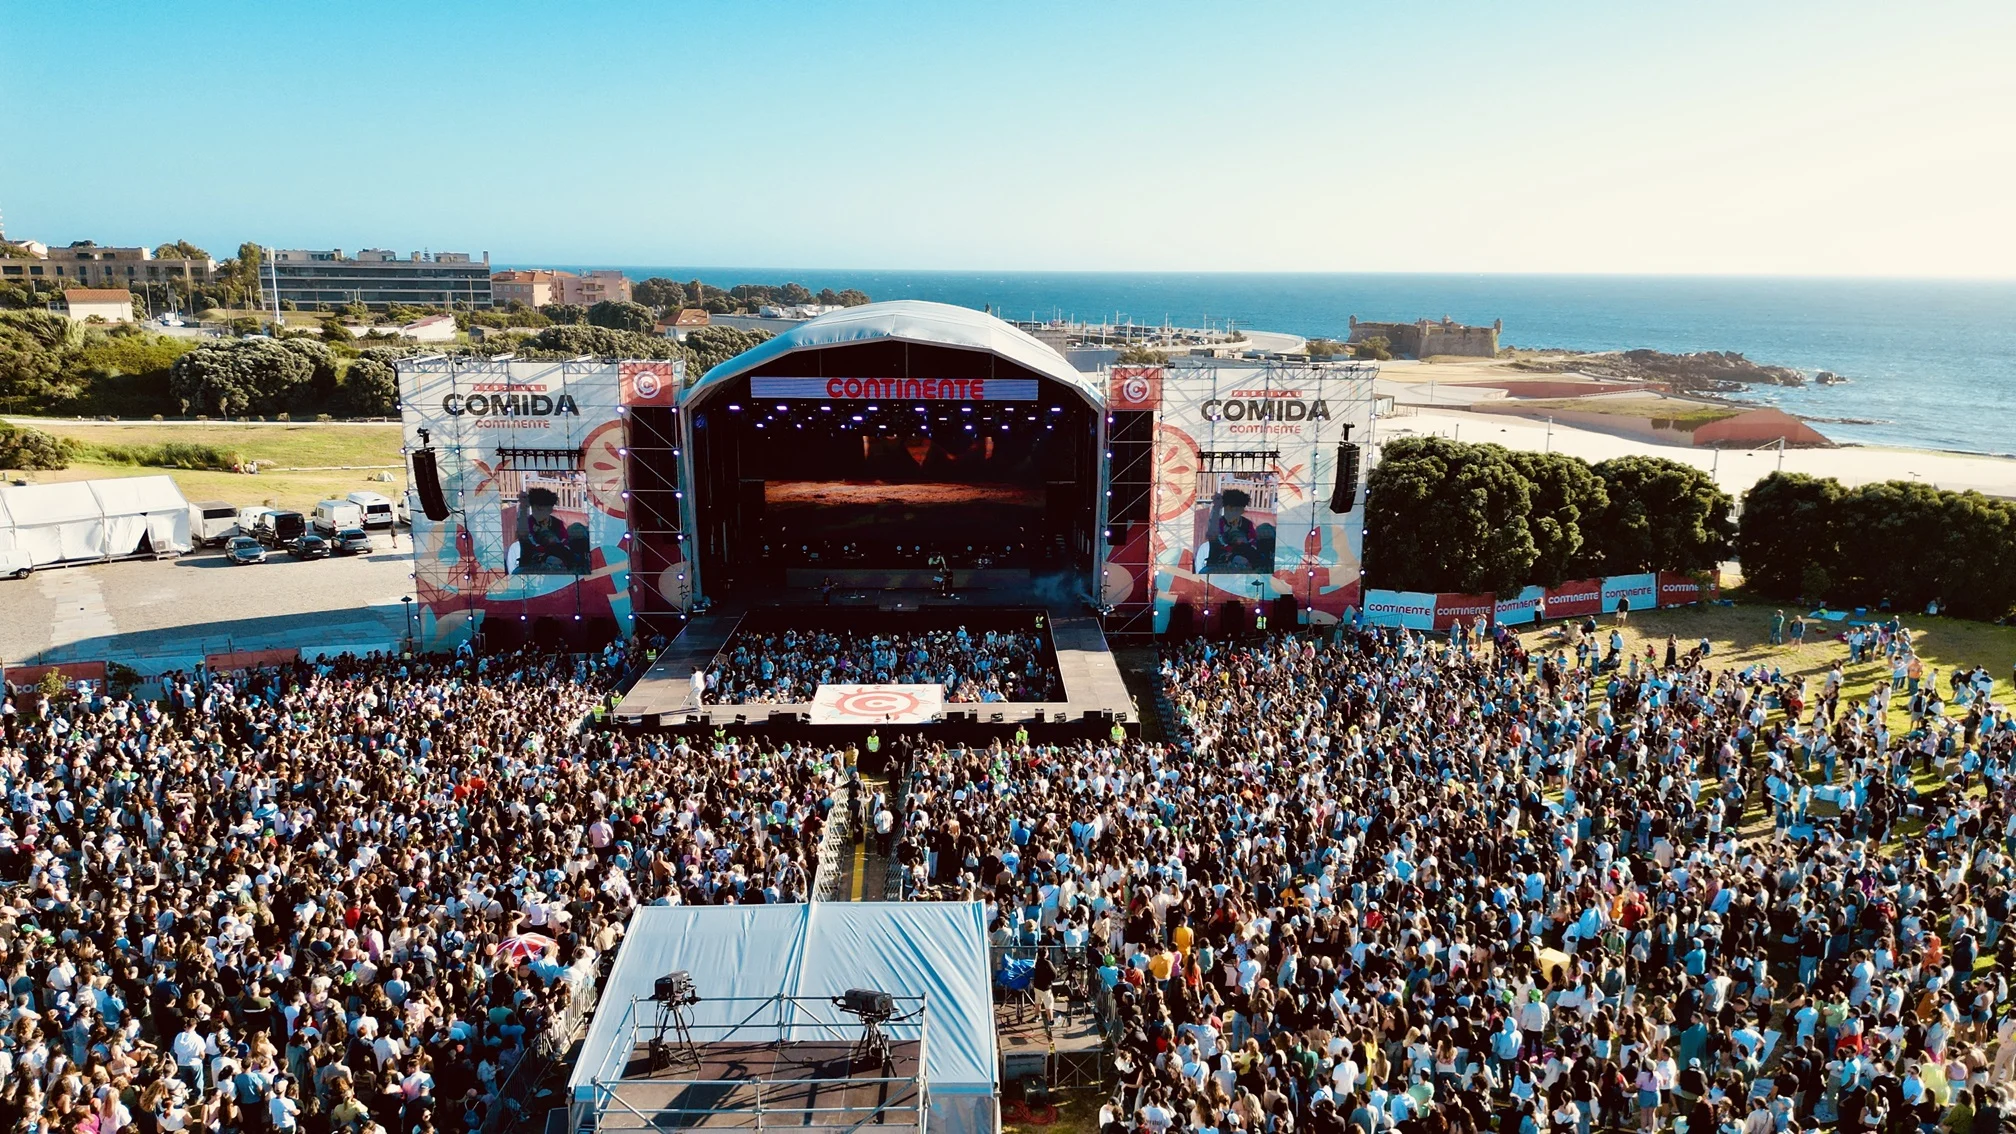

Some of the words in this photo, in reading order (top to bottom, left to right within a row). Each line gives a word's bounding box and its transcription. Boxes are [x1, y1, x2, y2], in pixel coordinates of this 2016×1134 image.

[826, 377, 984, 400] CONTINENTE
[442, 394, 580, 416] COMIDA
[1200, 399, 1332, 422] COMIDA
[475, 419, 550, 429] CONTINENTE
[1229, 424, 1301, 434] CONTINENTE
[1548, 591, 1599, 605] CONTINENTE
[1605, 586, 1652, 599] CONTINENTE
[1368, 603, 1431, 616] CONTINENTE
[1436, 606, 1492, 616] CONTINENTE
[1496, 598, 1538, 613] CONTINENT
